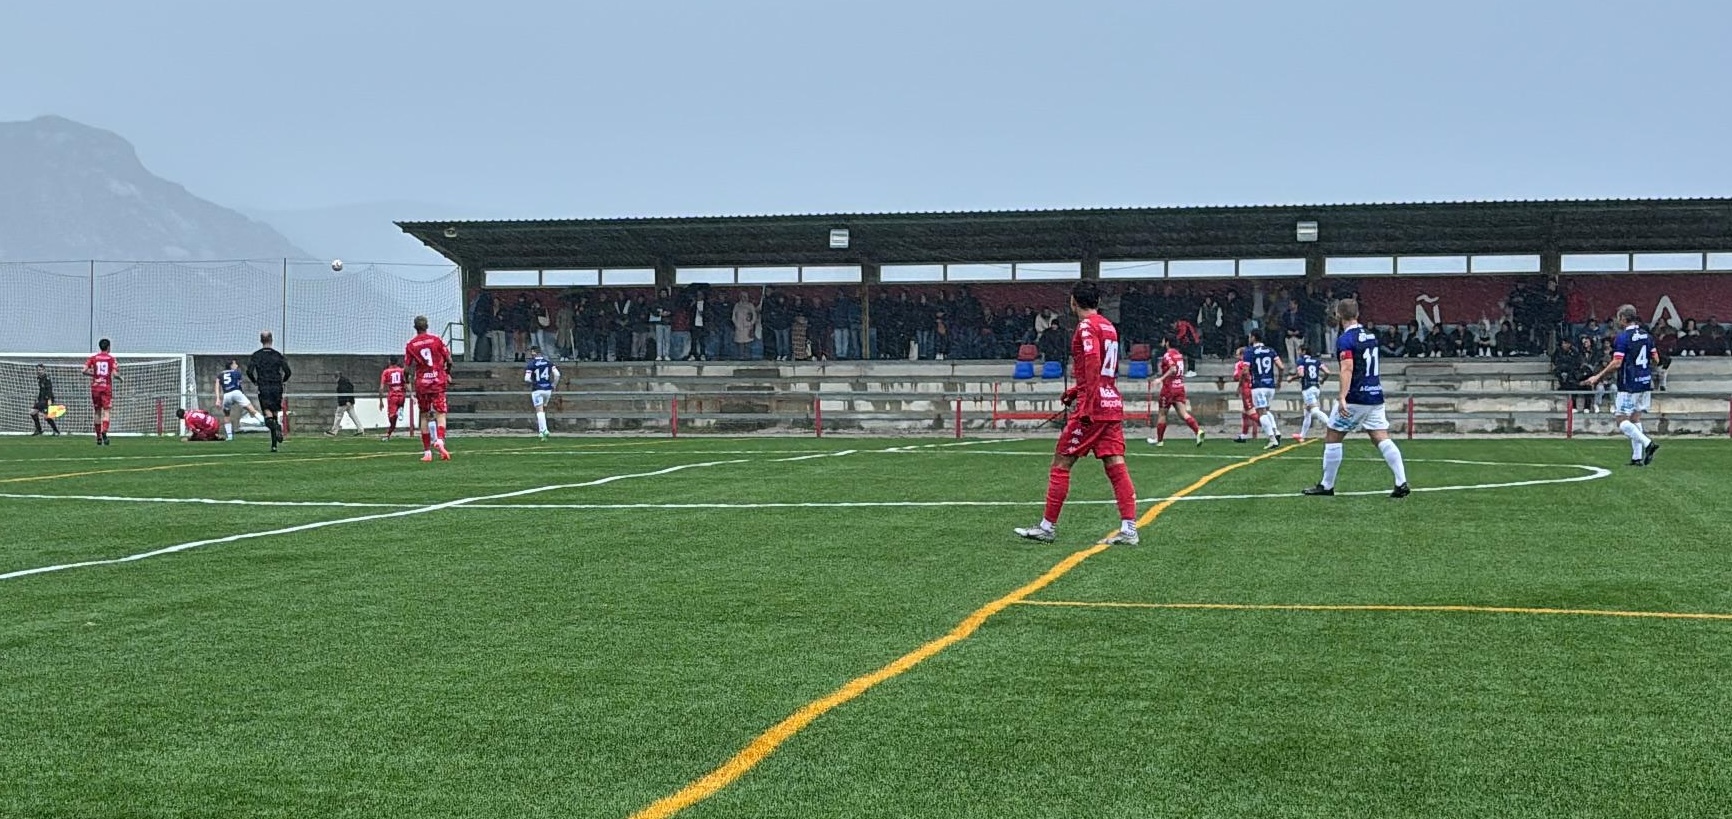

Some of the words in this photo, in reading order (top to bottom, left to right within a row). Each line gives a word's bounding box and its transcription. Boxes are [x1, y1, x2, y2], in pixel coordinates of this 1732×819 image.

[1415, 294, 1440, 334] Ñ
[1649, 295, 1686, 339] A
[420, 347, 433, 367] 9
[1100, 338, 1119, 377] 20
[1255, 356, 1272, 375] 19
[1362, 346, 1379, 377] 11
[1635, 344, 1649, 369] 4
[95, 361, 109, 375] 19
[390, 371, 401, 384] 10
[534, 366, 550, 381] 14
[1308, 365, 1317, 379] 8
[223, 373, 231, 385] 5
